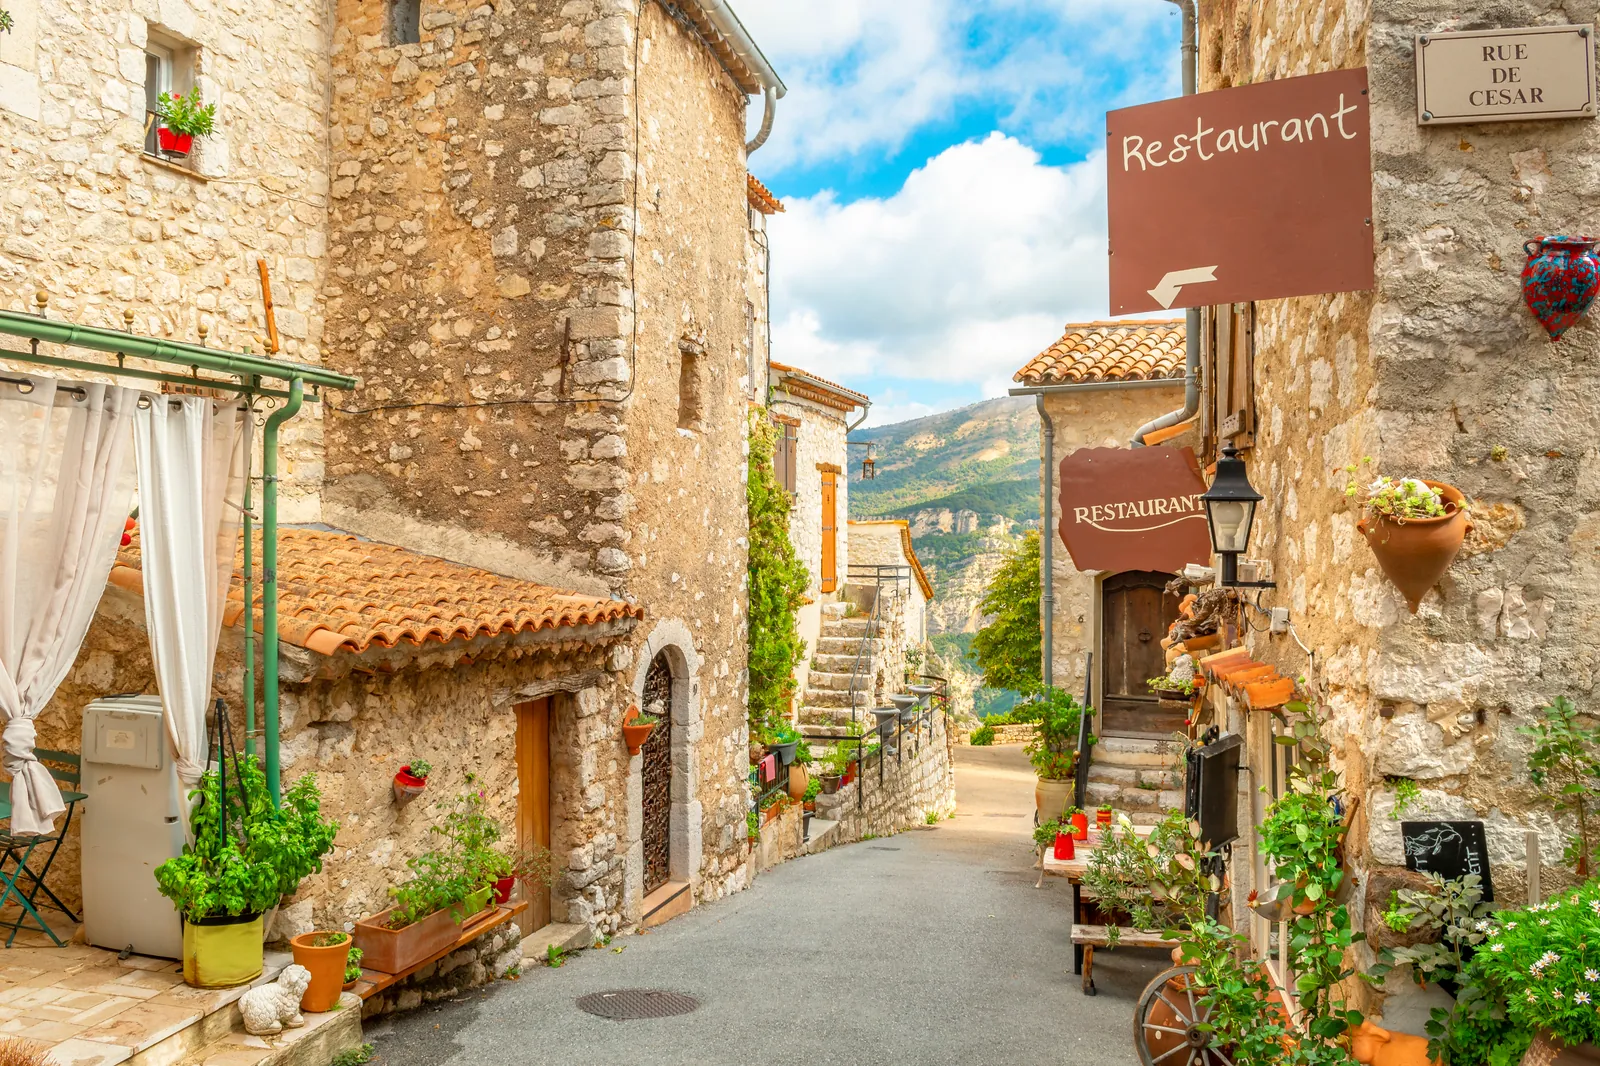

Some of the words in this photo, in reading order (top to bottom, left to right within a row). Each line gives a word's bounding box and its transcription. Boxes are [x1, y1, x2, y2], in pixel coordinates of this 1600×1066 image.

[1482, 43, 1528, 61] RUE
[1492, 67, 1521, 84] DE
[1469, 87, 1544, 106] CESAR
[1122, 93, 1358, 171] Restaurant
[1073, 493, 1206, 525] RESTAURANT
